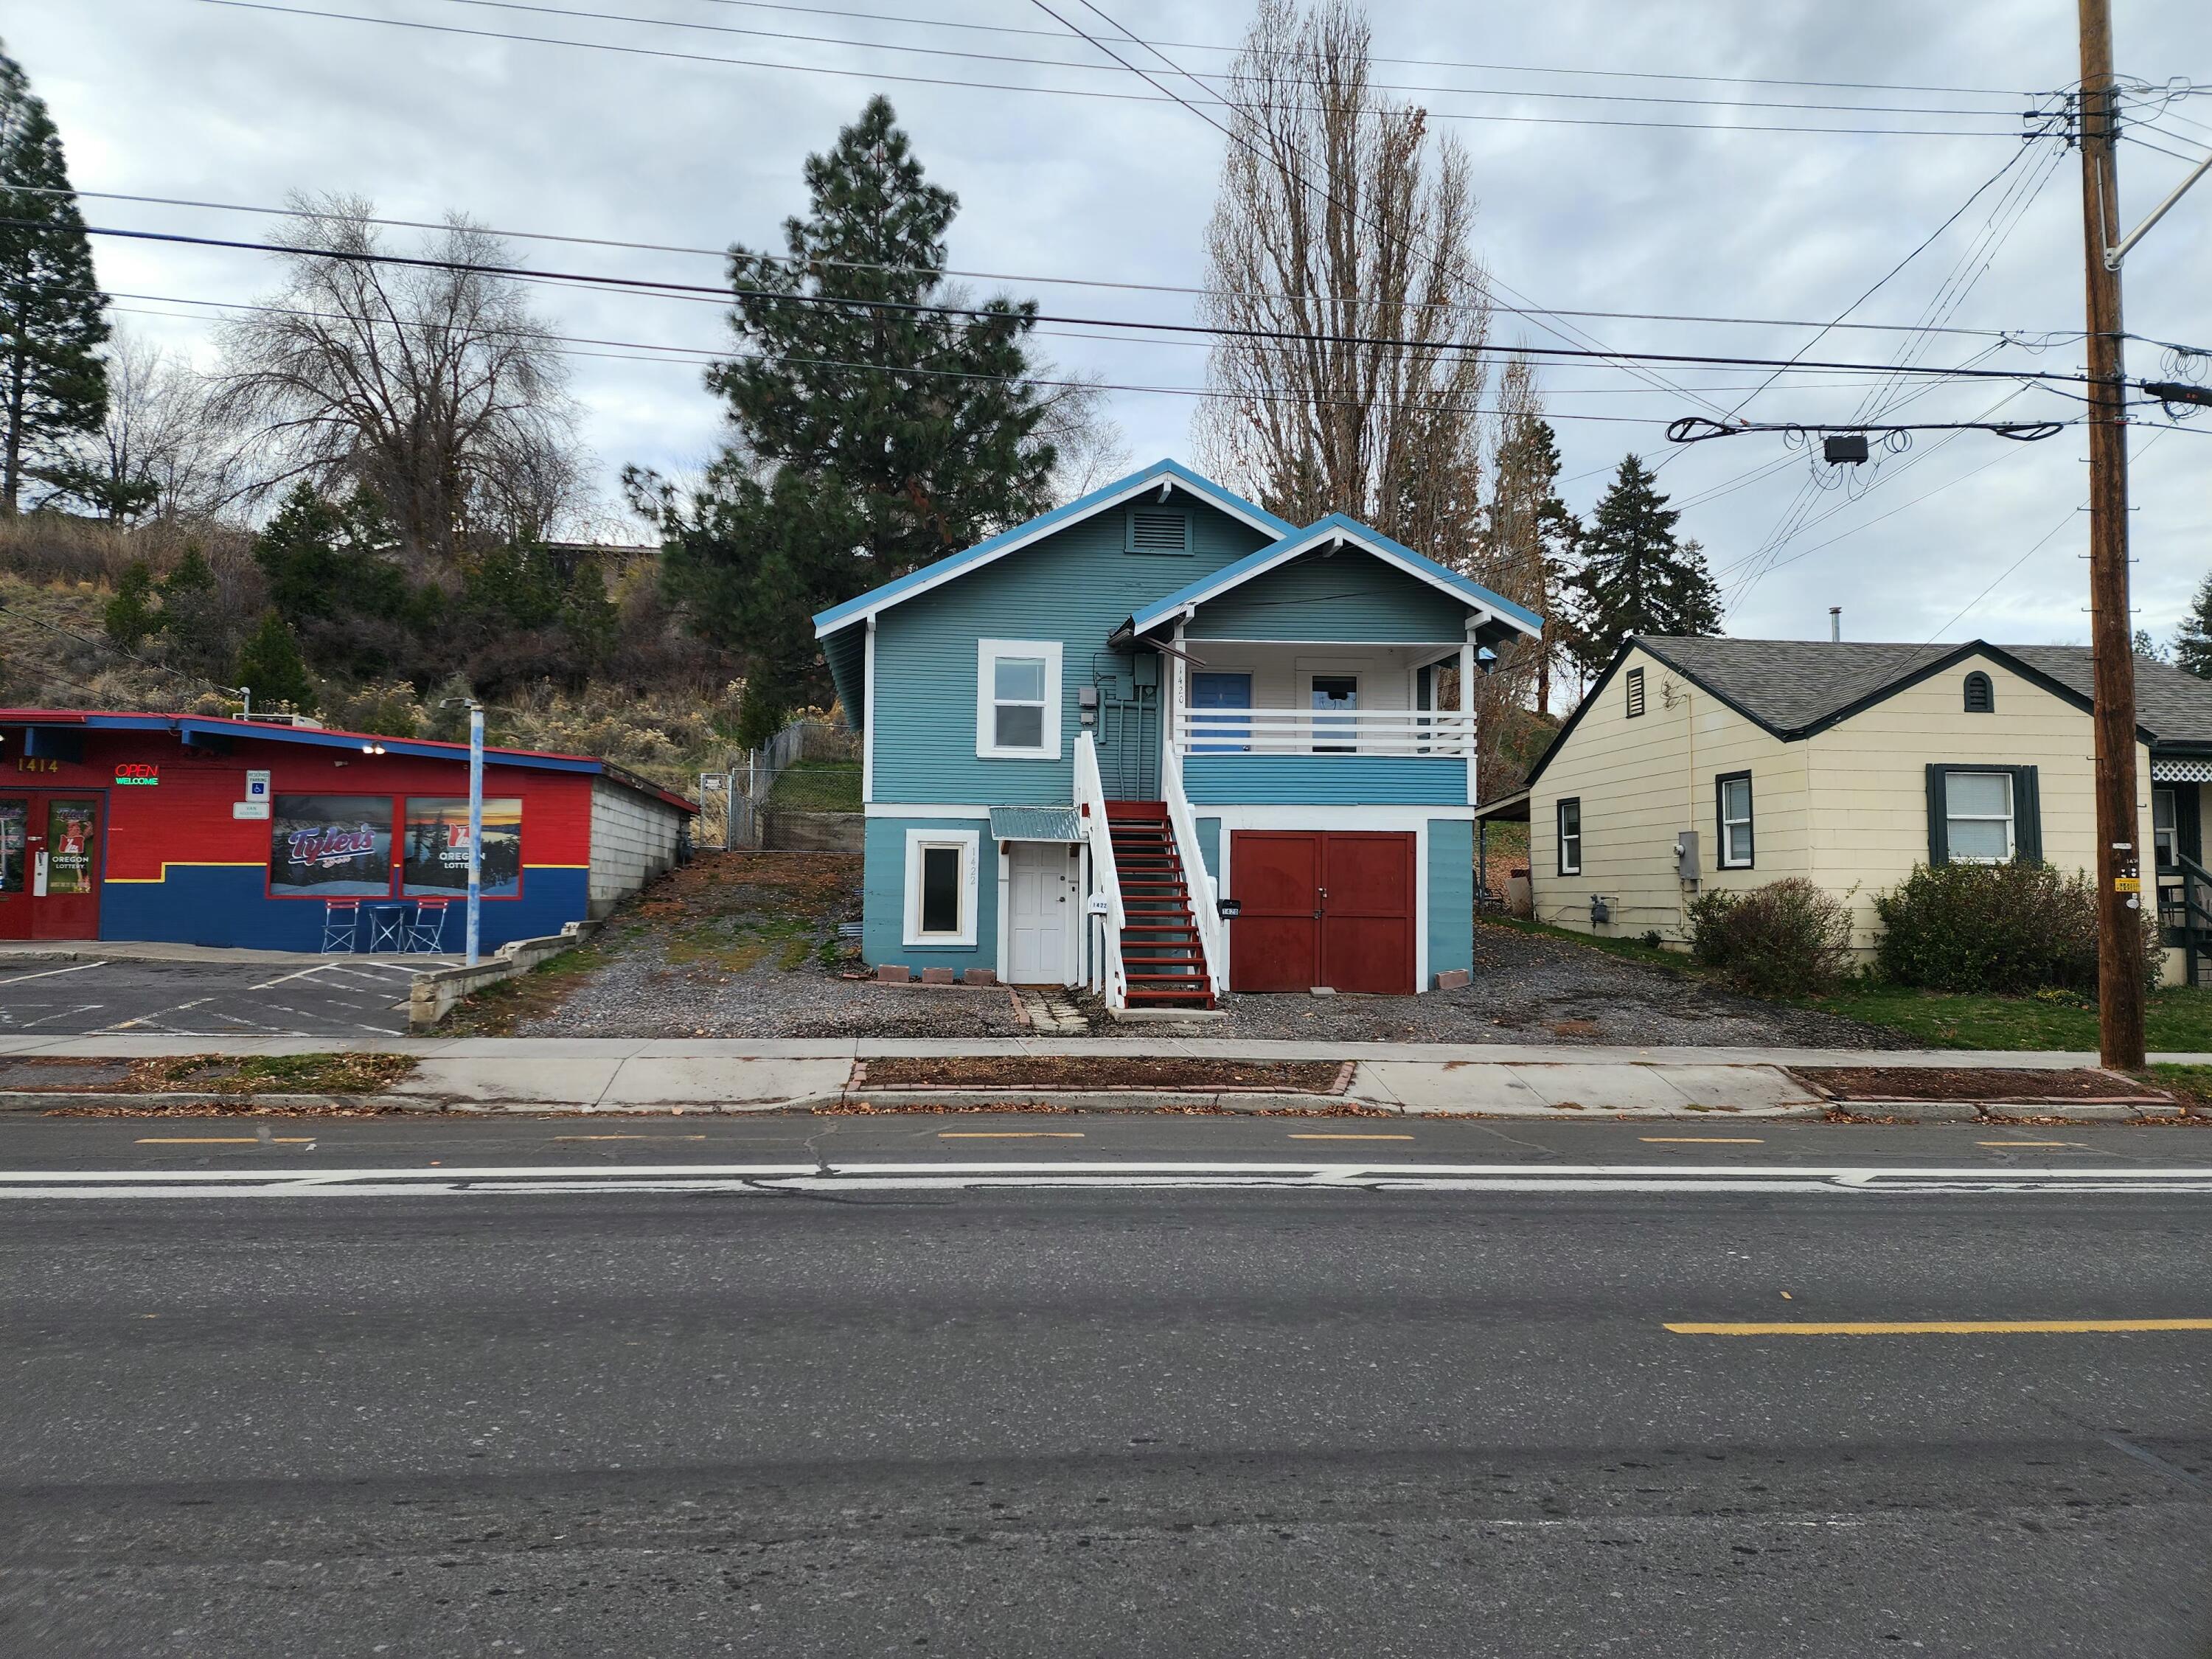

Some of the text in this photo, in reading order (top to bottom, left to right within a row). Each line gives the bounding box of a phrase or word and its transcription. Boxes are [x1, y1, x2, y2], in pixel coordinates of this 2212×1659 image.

[18, 758, 58, 773] 1414
[115, 764, 159, 777] OPEN
[115, 777, 159, 785] WELCOME
[288, 823, 375, 866] Tyler's
[439, 852, 486, 860] OREGN
